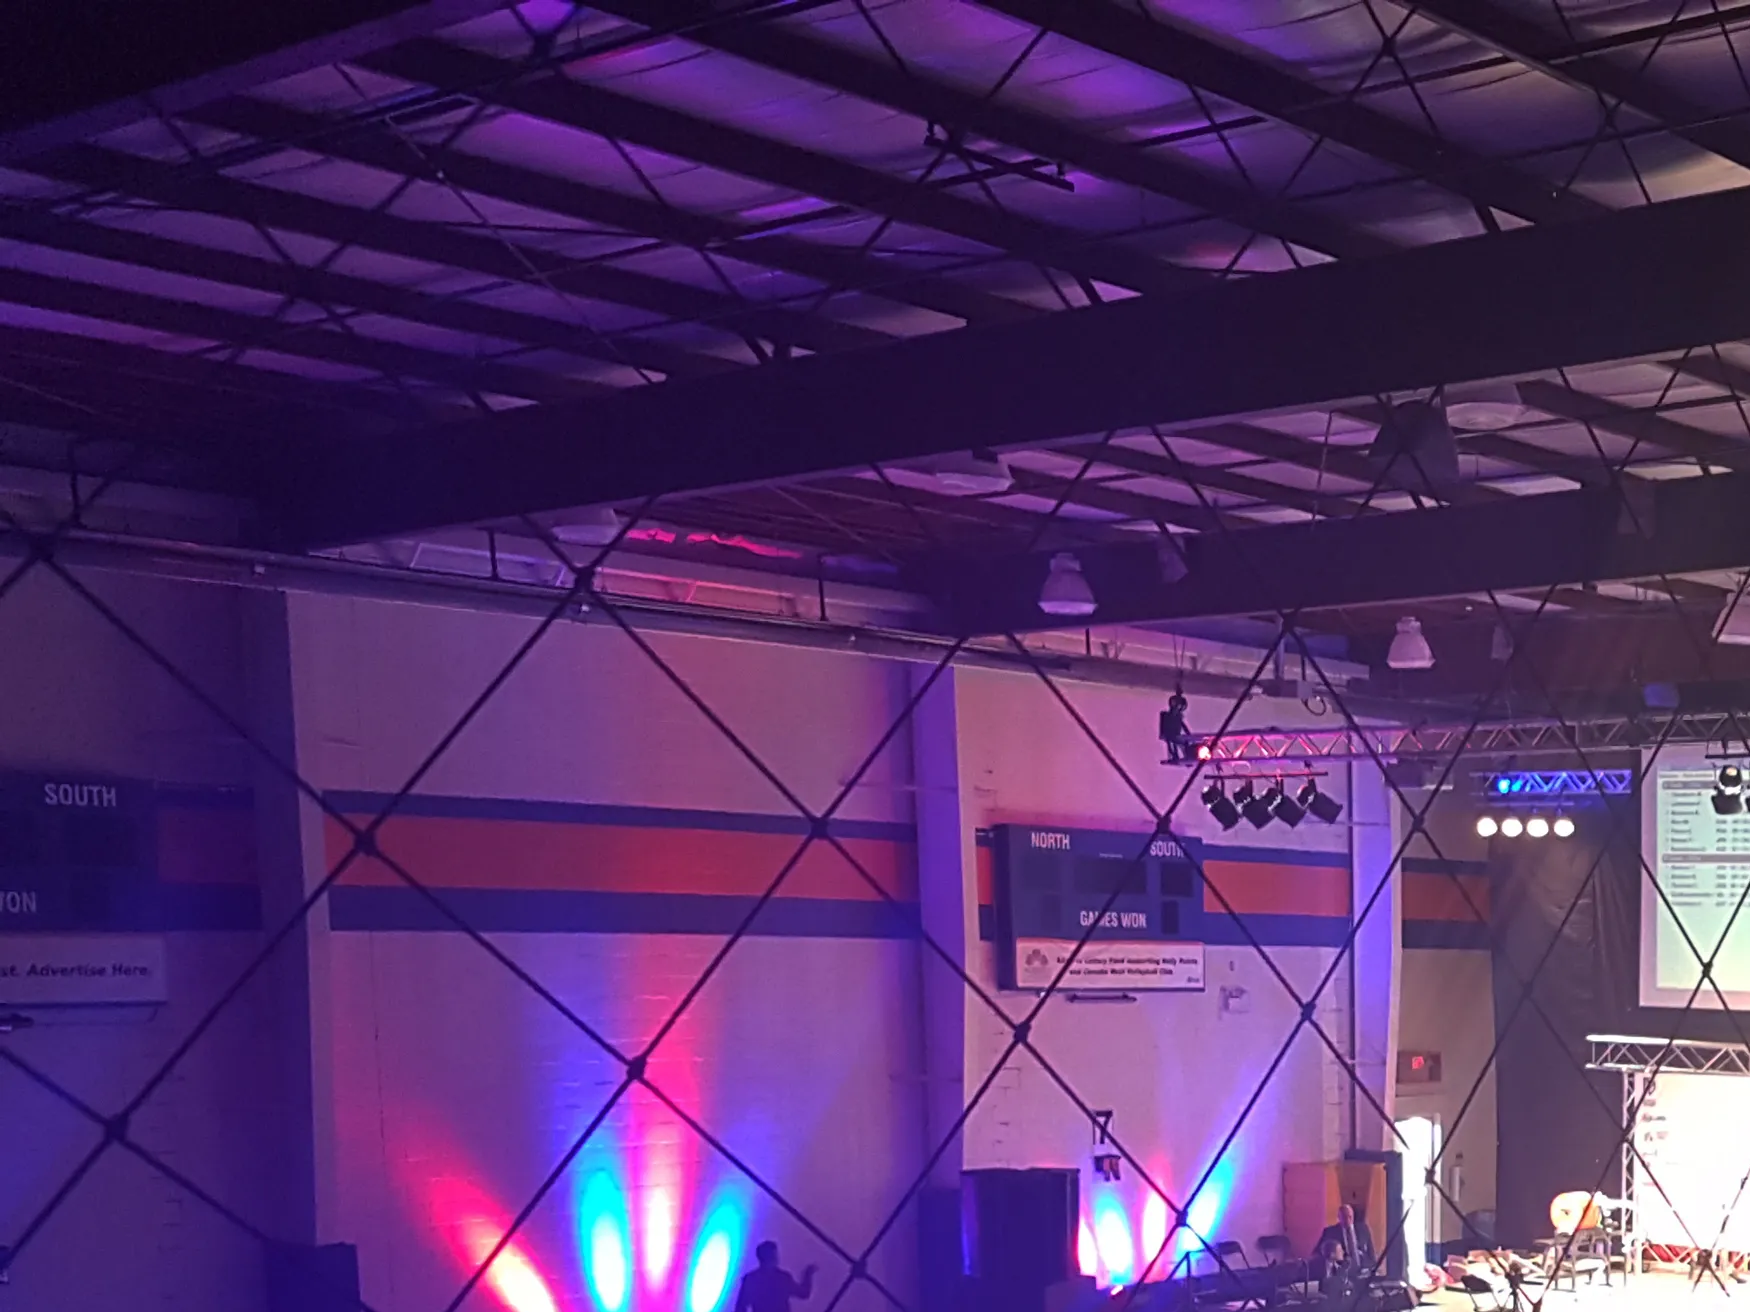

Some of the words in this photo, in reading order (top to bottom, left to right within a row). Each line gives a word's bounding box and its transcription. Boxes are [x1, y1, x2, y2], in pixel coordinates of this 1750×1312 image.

[44, 783, 117, 807] SOUTH
[1031, 832, 1071, 850] NORTH
[1121, 912, 1147, 928] WON
[26, 963, 106, 978] Advertise
